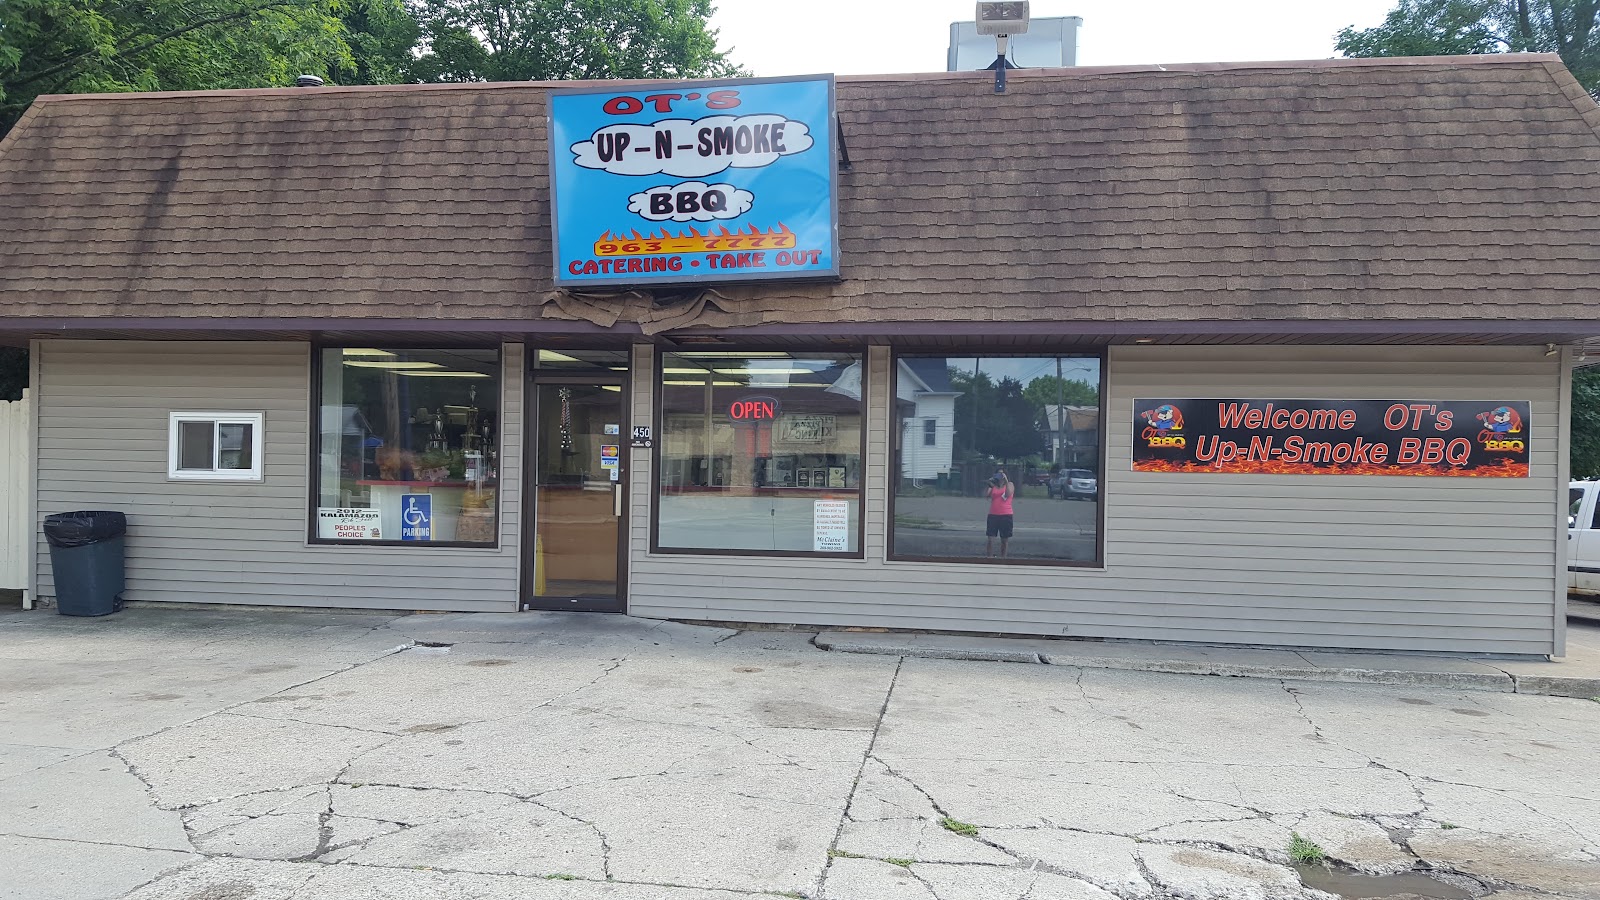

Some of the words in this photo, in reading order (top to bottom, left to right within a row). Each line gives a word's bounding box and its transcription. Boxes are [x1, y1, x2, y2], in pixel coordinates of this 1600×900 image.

[603, 90, 741, 115] OT'S
[650, 189, 728, 214] BBQ
[569, 256, 683, 275] CATERING
[706, 252, 766, 269] TAKE
[775, 250, 822, 266] OUT
[731, 402, 774, 419] OPEN
[1219, 403, 1356, 430] Welcome
[1384, 404, 1453, 431] OT's
[634, 427, 650, 438] 450
[1148, 436, 1186, 449] BBQ
[1196, 435, 1388, 468] Up-N-Smoke
[1397, 437, 1471, 465] BBQ
[1484, 440, 1524, 453] BBQ
[403, 527, 430, 537] PARKING
